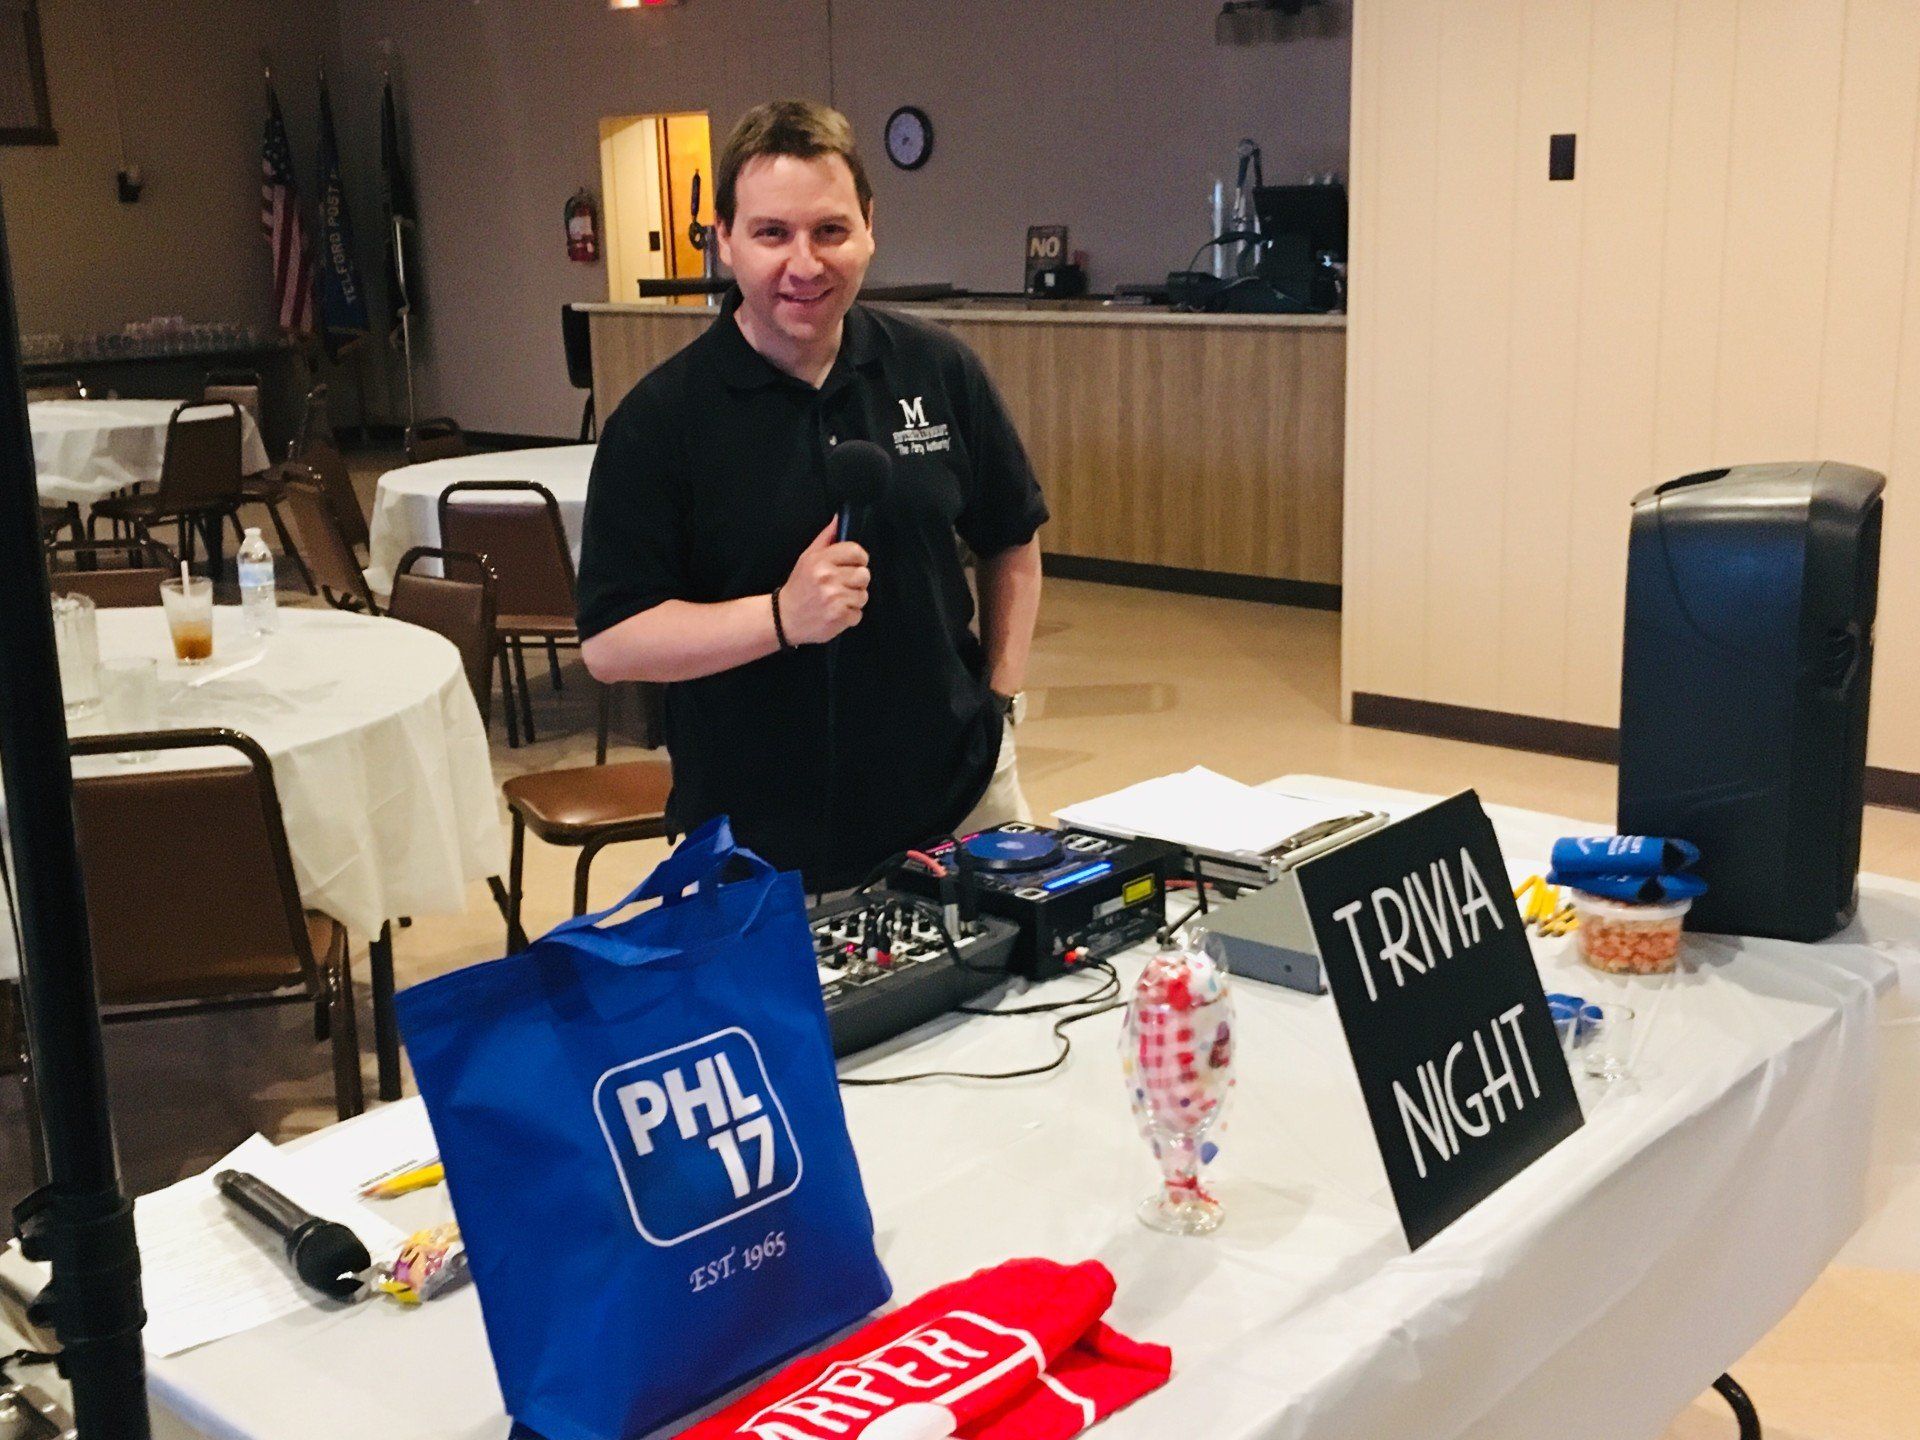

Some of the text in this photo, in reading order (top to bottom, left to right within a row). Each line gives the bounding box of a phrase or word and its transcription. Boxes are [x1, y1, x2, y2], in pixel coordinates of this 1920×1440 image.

[1030, 236, 1061, 258] NO
[898, 396, 930, 429] M
[1333, 847, 1504, 1002] TRIVIA
[616, 1051, 764, 1157] PHL
[1392, 1003, 1541, 1179] NIGHT
[707, 1113, 775, 1199] 17
[689, 1230, 787, 1293] EST. 1965
